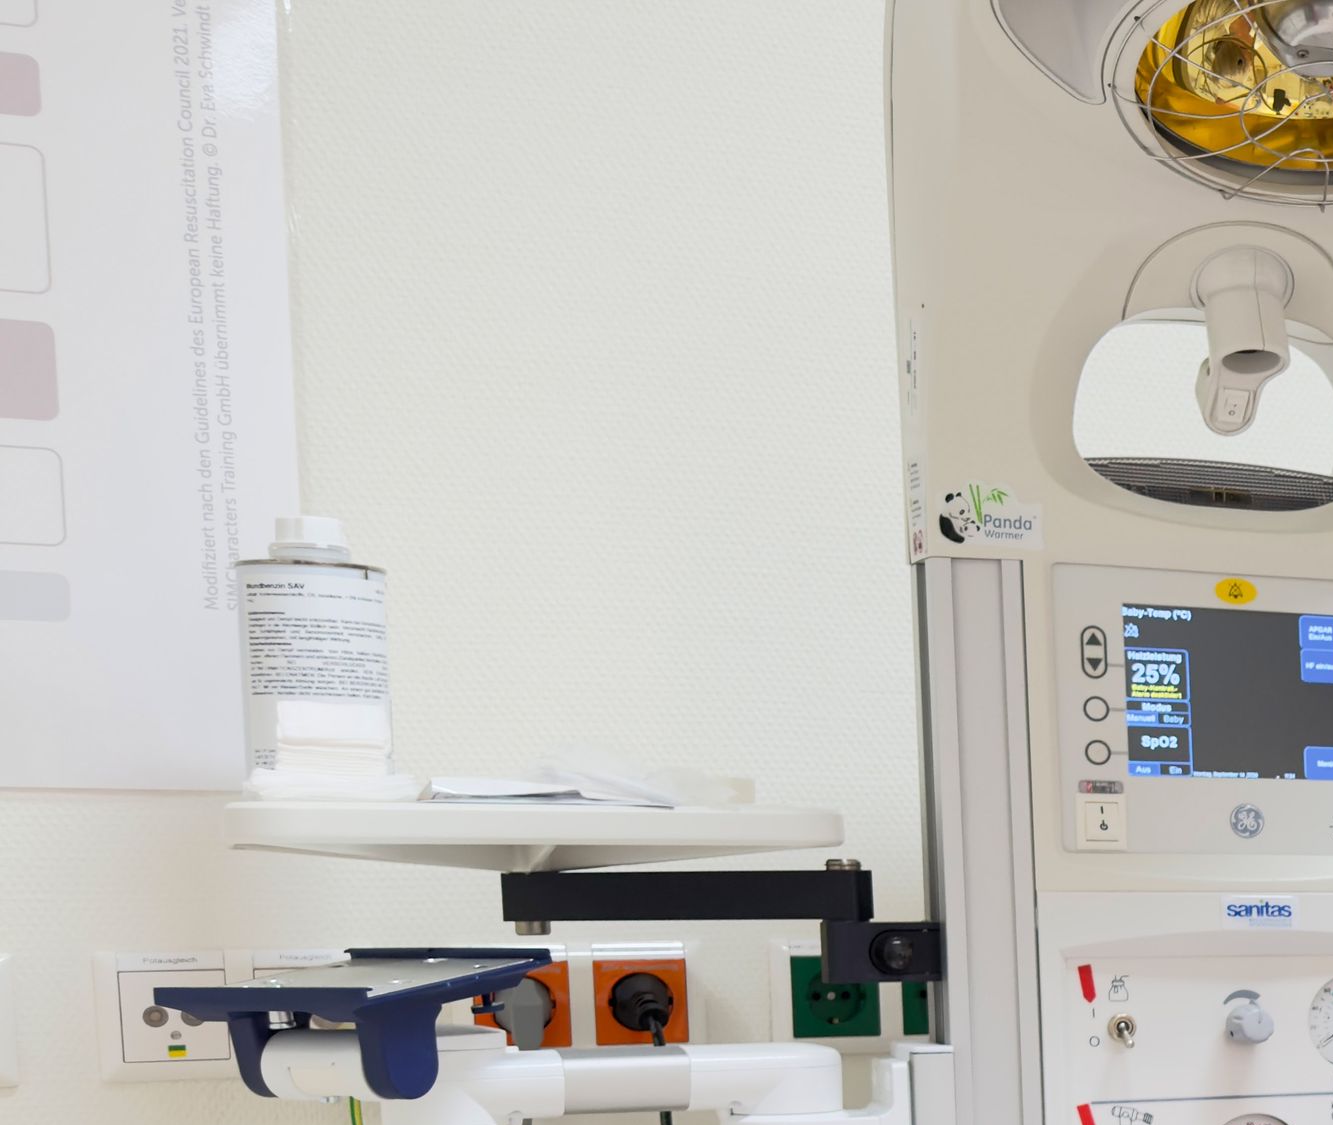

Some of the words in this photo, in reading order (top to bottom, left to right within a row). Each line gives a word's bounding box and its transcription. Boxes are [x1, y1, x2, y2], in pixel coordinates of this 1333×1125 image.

[175, 70, 193, 133] Council
[200, 85, 216, 111] Eva
[201, 116, 217, 139] Dr.
[181, 137, 199, 244] Resuscitation
[205, 162, 222, 231] Haftung.
[208, 235, 225, 277] keine
[187, 248, 205, 324] European
[211, 282, 229, 371] übernimmt
[189, 329, 206, 357] des
[192, 361, 210, 444] Guidelines
[215, 375, 232, 426] GmbH
[196, 449, 212, 479] den
[219, 430, 237, 493] Training
[197, 484, 215, 521] nach
[983, 514, 1033, 531] Panda
[985, 530, 1024, 540] Warmer
[201, 527, 219, 610] Modifiziert
[1120, 606, 1172, 620] Baby-Temp
[1131, 662, 1181, 686] 25%
[1141, 702, 1173, 713] Modus
[1163, 714, 1185, 725] Baby
[1140, 735, 1179, 750] SpO2
[1135, 765, 1152, 774] Aus
[1168, 765, 1183, 775] Ein
[1226, 899, 1292, 918] sanitas
